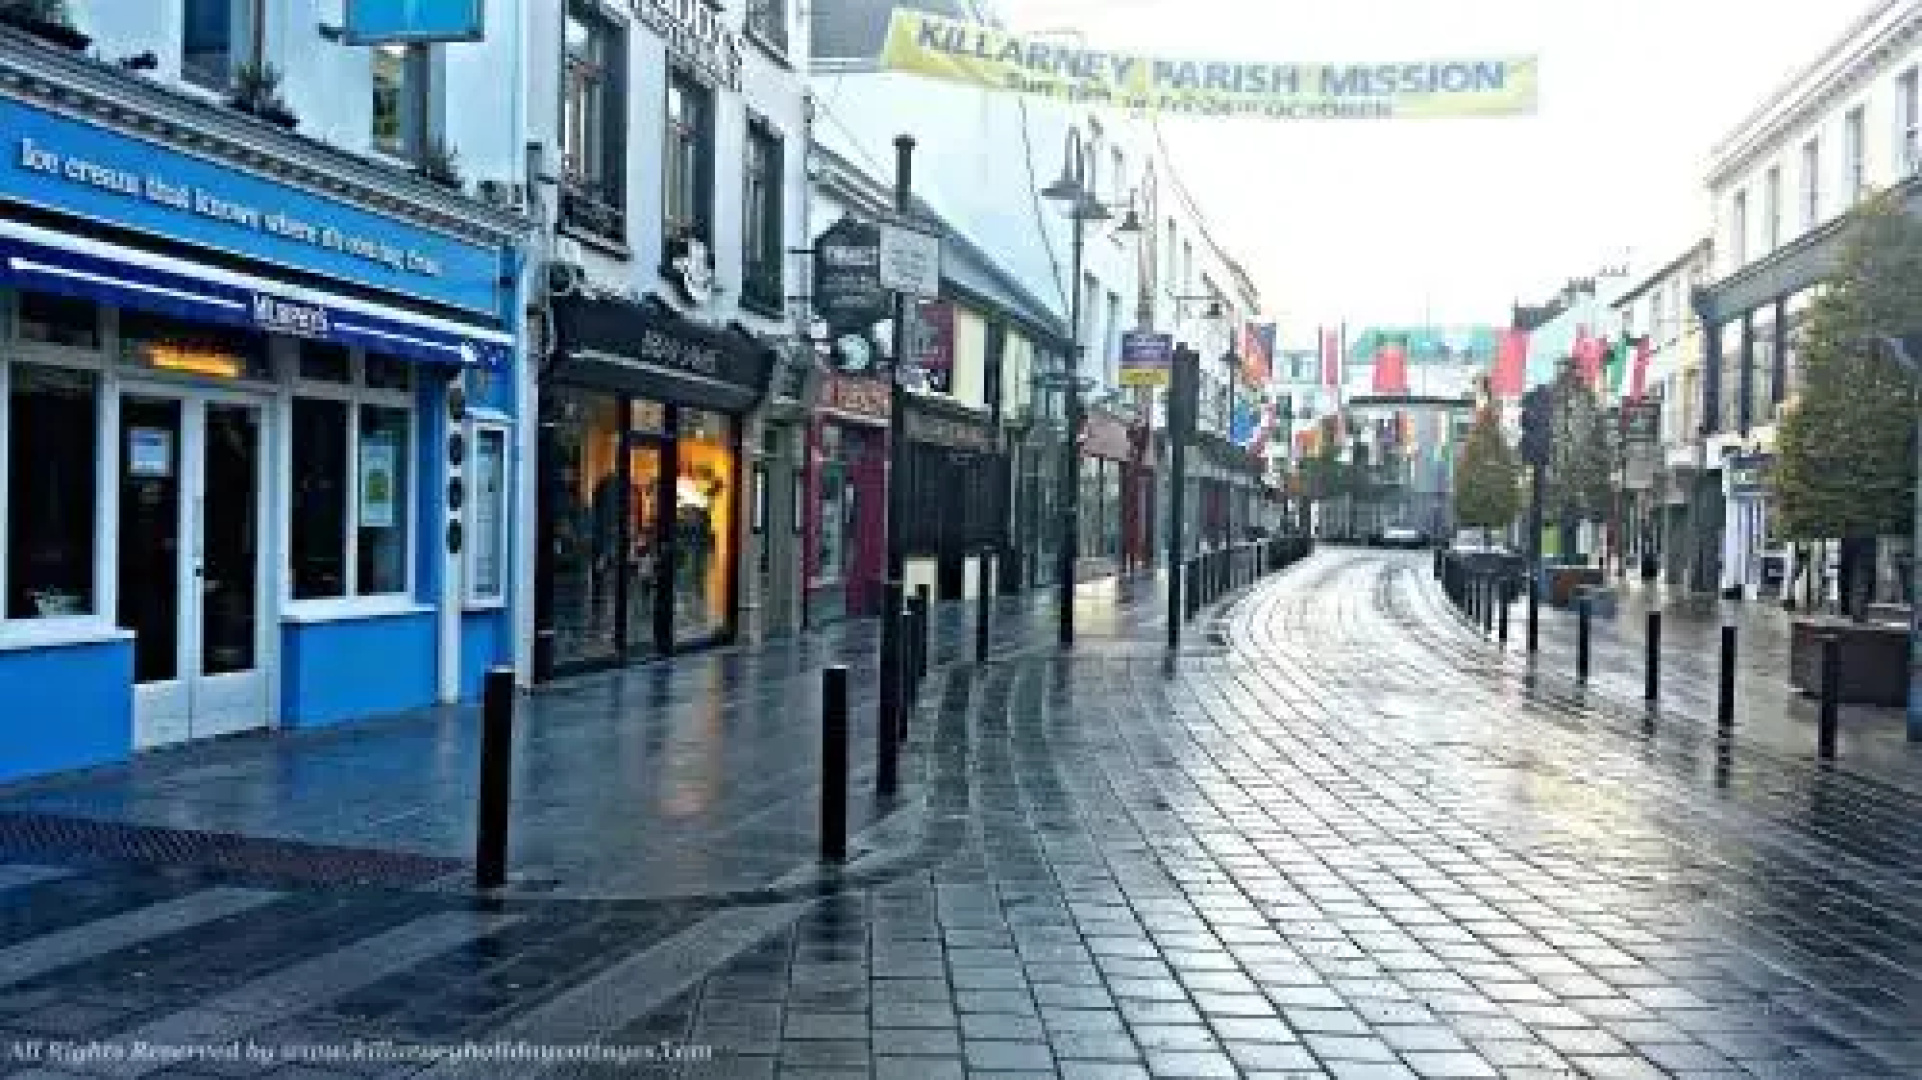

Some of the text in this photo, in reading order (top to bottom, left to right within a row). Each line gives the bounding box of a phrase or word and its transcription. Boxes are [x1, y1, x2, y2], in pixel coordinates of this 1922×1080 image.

[918, 18, 1507, 96] KILLARNEY PARISH MISSION
[21, 138, 62, 175] Ice
[65, 157, 142, 195] cream
[145, 173, 191, 210] that
